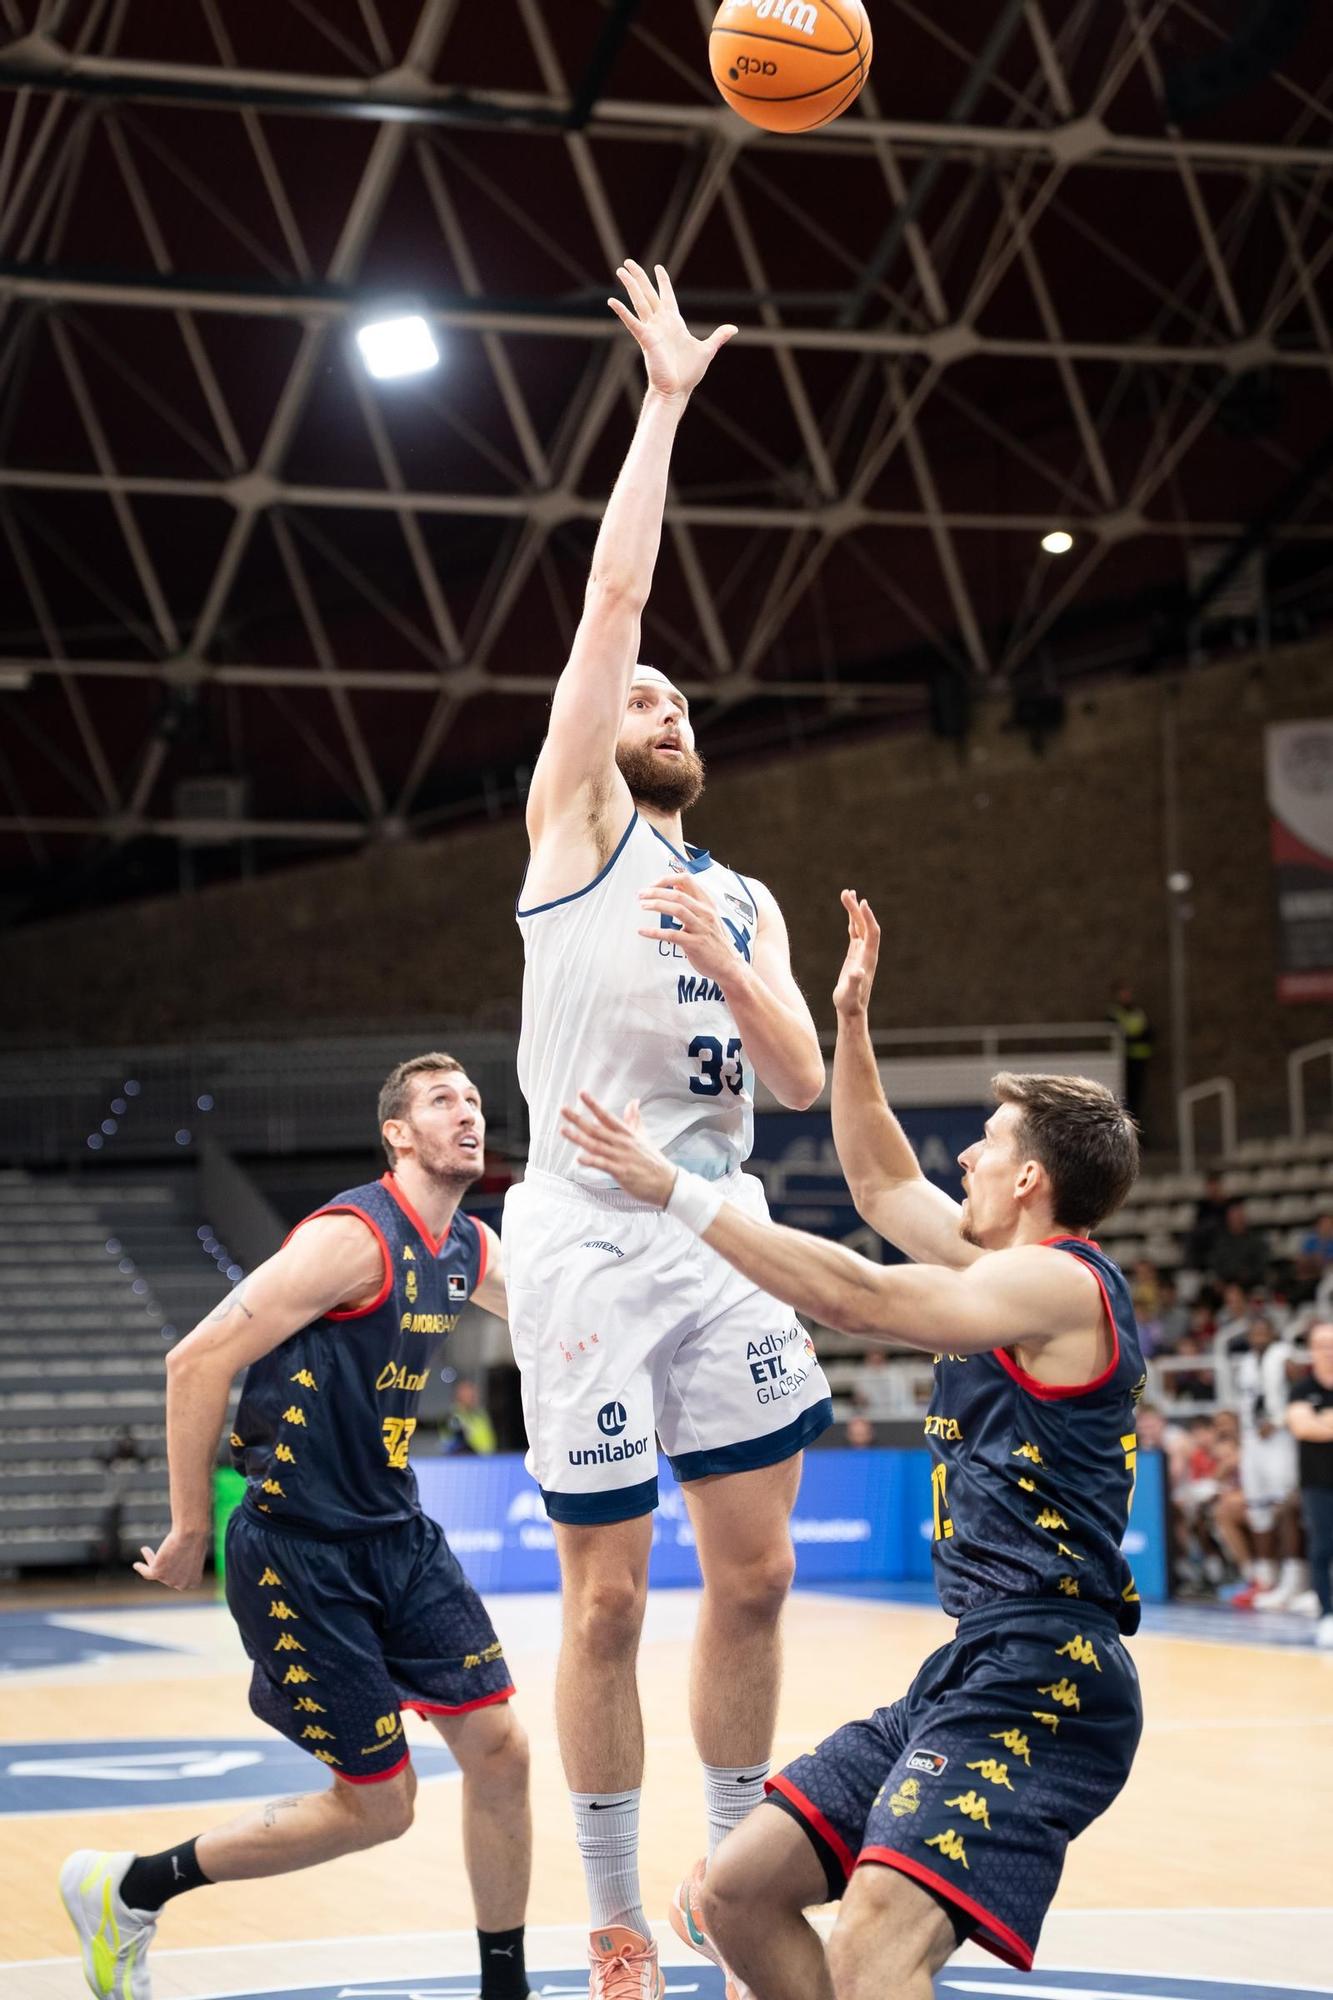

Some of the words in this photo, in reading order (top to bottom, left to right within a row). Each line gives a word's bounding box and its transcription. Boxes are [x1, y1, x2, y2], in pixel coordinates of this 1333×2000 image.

[737, 55, 777, 76] acb
[688, 1035, 744, 1096] 33
[750, 1355, 787, 1384] ETL
[568, 1436, 648, 1466] unilabor
[910, 1757, 935, 1770] acb
